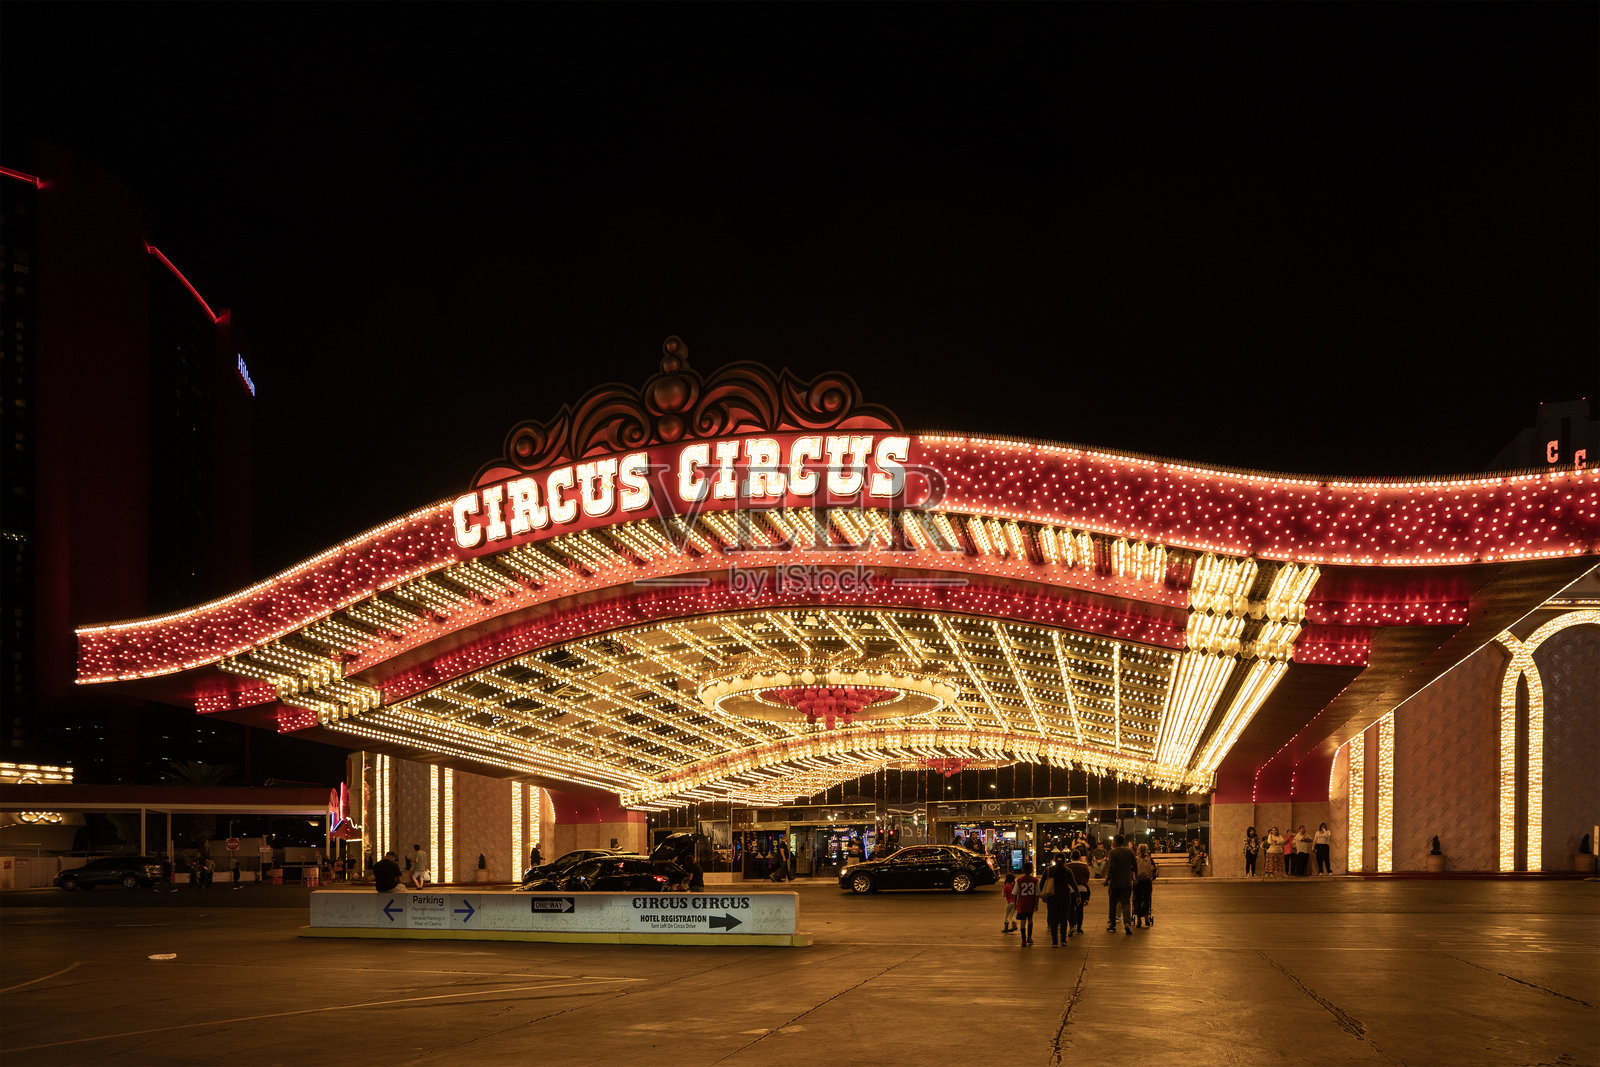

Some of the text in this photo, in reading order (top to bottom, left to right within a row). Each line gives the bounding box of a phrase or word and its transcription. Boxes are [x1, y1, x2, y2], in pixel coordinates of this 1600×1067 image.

[452, 435, 910, 549] CIRCUS CIRCUS
[1021, 882, 1035, 896] 23
[412, 895, 444, 906] Parking
[632, 897, 750, 909] CIRCUS CIRCUS
[660, 915, 707, 923] REGISTRATION
